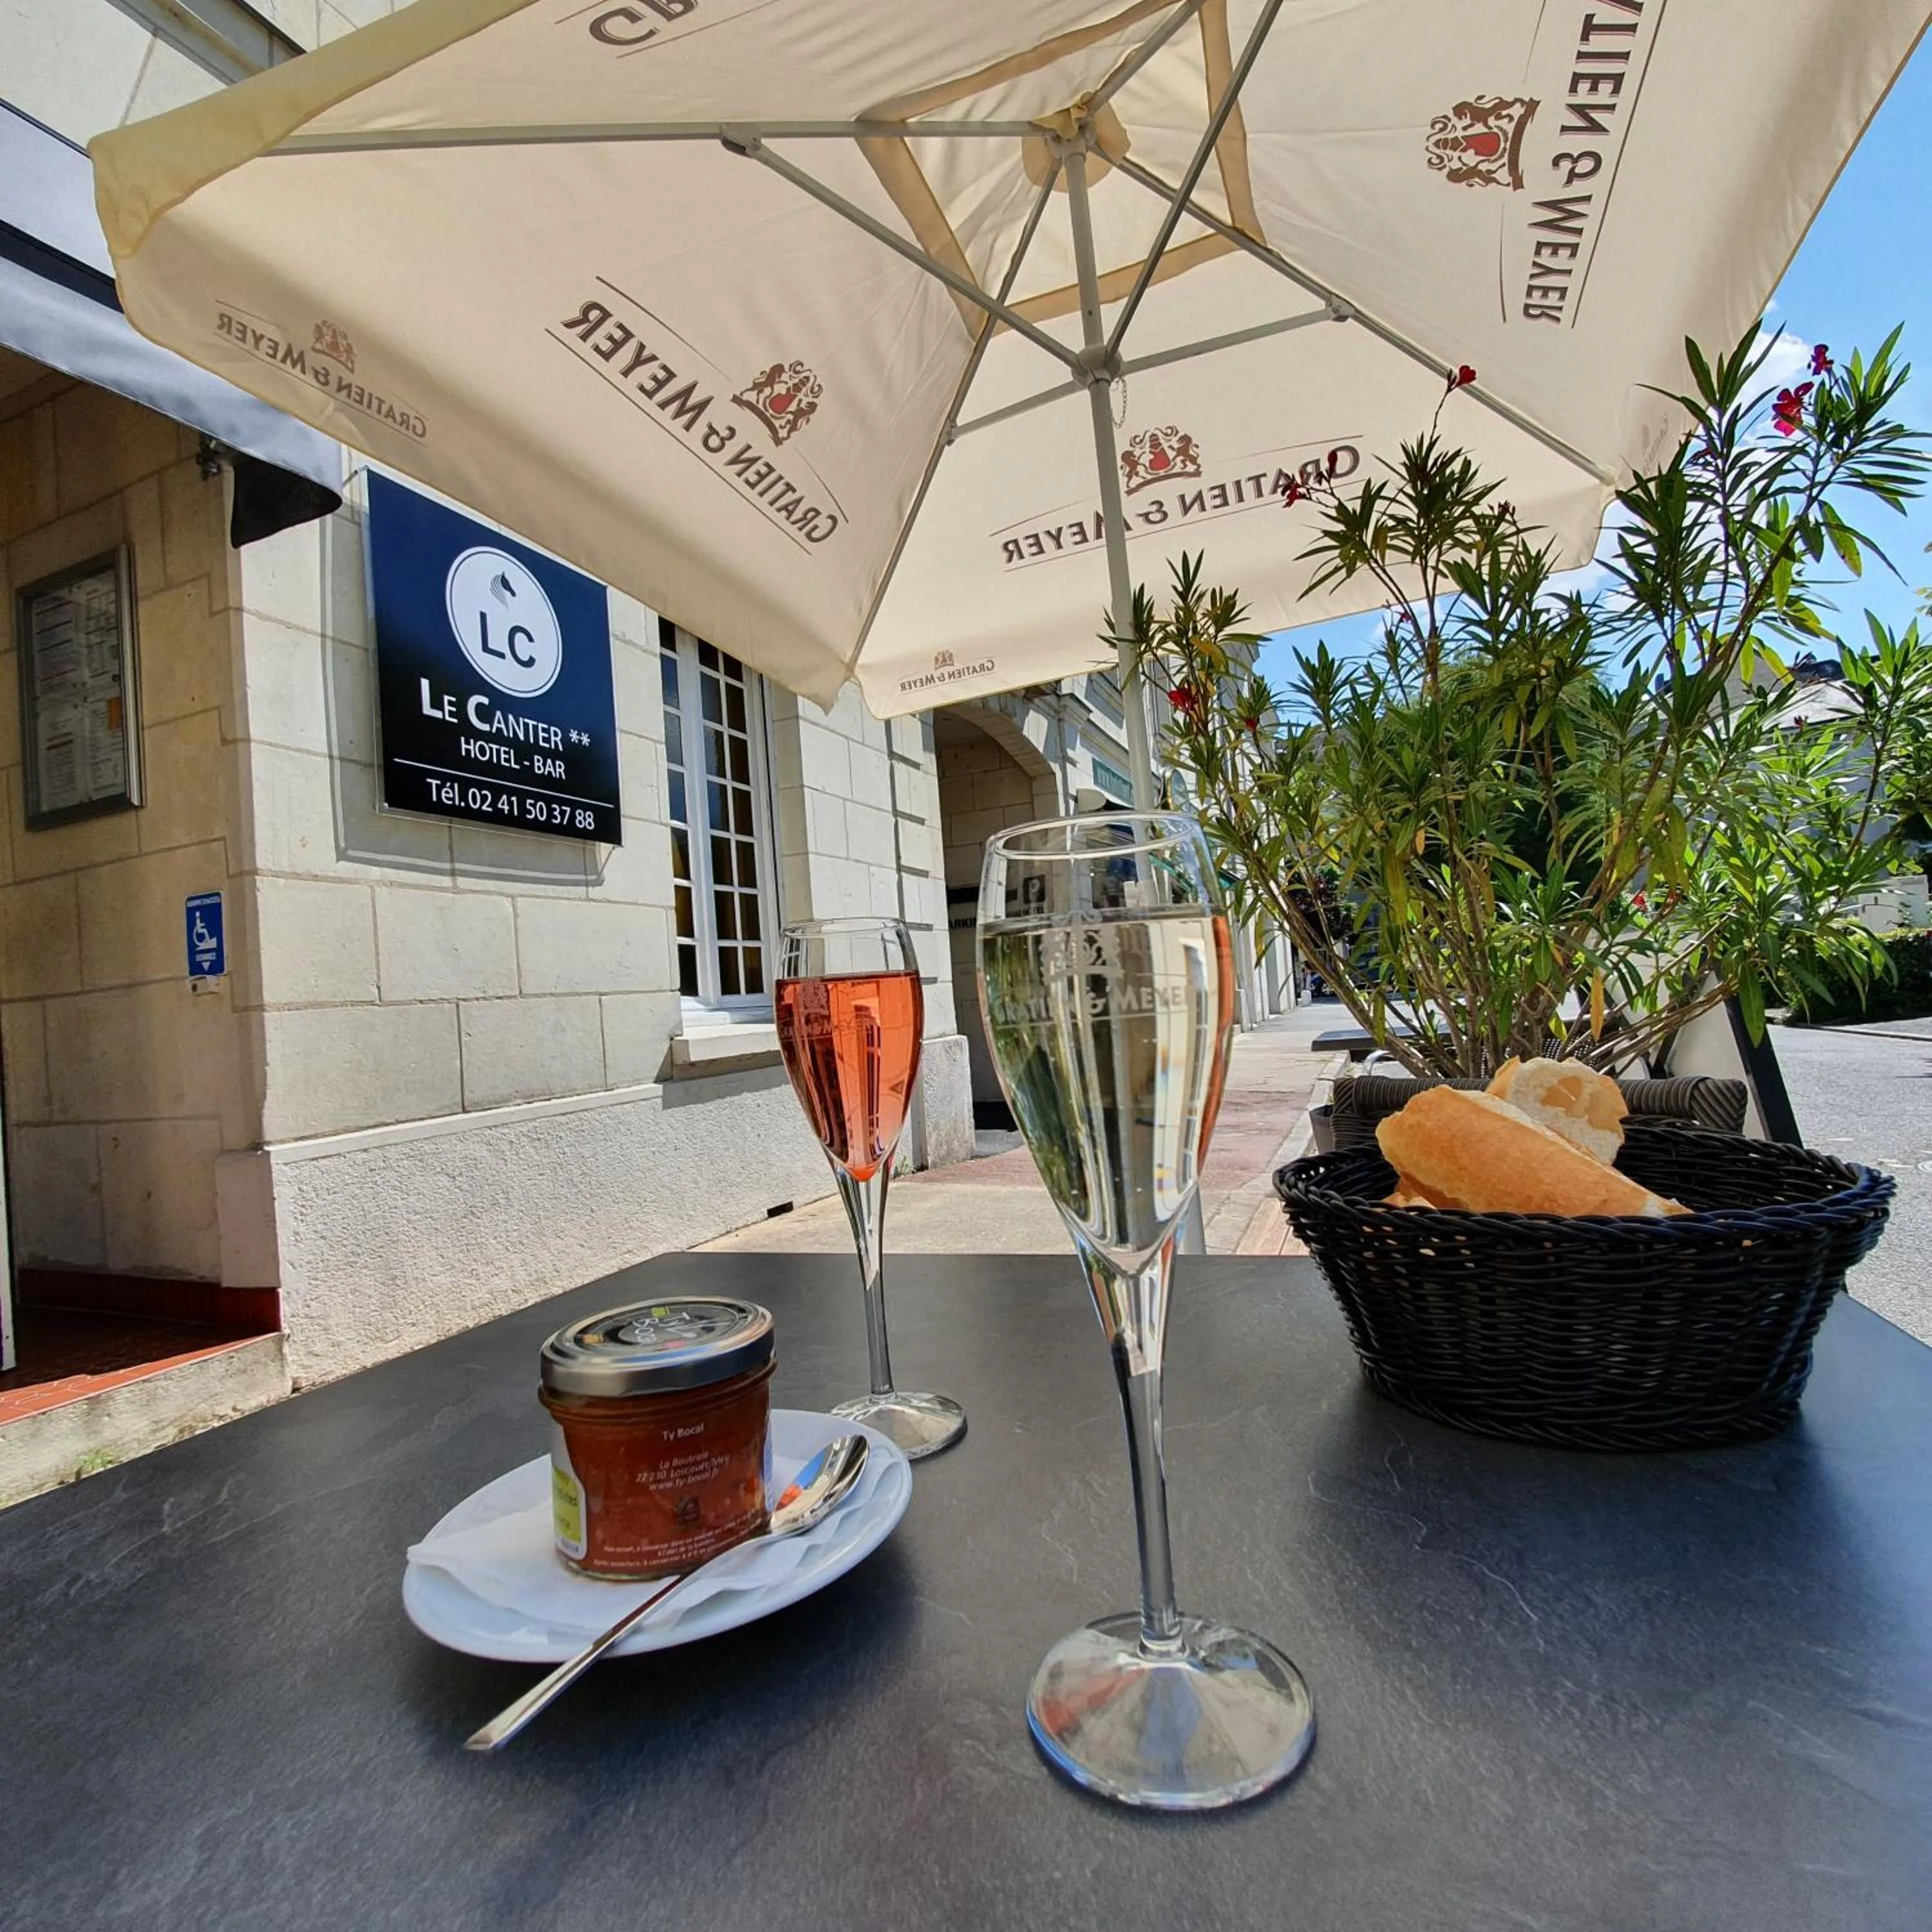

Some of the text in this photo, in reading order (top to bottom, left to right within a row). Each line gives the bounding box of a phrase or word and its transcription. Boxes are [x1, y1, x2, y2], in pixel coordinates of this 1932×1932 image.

[480, 611, 536, 668] LC
[419, 677, 563, 752] LE CANTER
[461, 737, 520, 769] HOTEL
[533, 755, 565, 780] BAR
[498, 794, 518, 817] 41
[526, 799, 547, 821] 50
[551, 804, 571, 825] 37
[575, 809, 594, 830] 88
[661, 1422, 704, 1442] Ty Bocal
